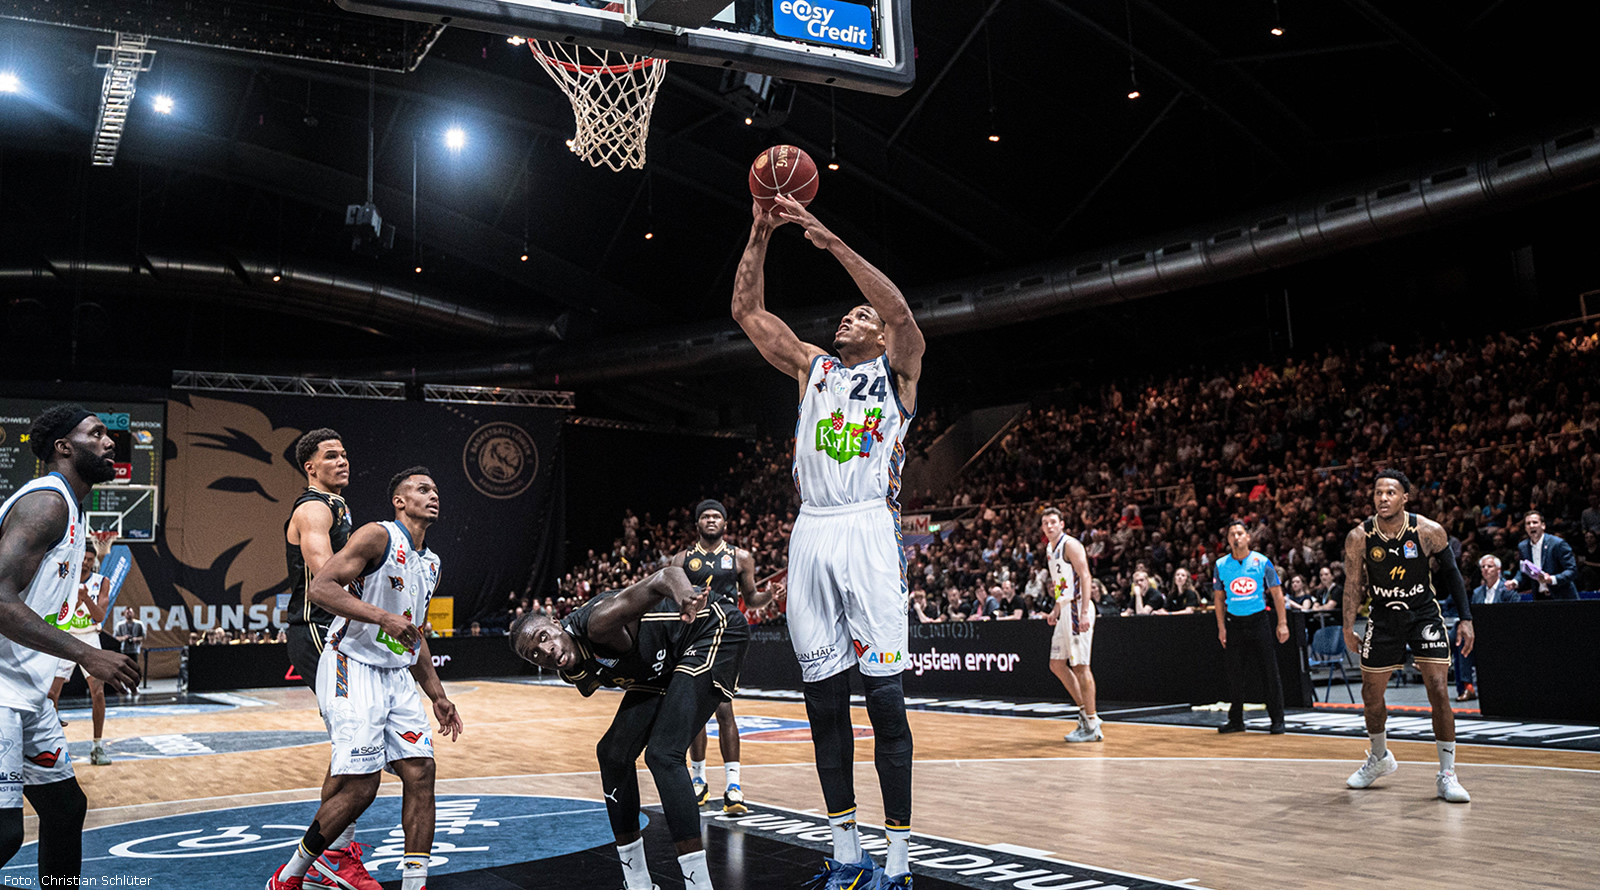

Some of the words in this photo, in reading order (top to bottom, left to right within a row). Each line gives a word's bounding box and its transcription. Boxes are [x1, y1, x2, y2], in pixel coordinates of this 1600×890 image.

[807, 19, 867, 45] Credit
[849, 373, 887, 403] 24
[1389, 565, 1407, 581] 14
[1372, 583, 1425, 598] vwfs.de
[868, 650, 902, 664] AIDA
[905, 647, 962, 676] system
[964, 652, 1021, 672] error
